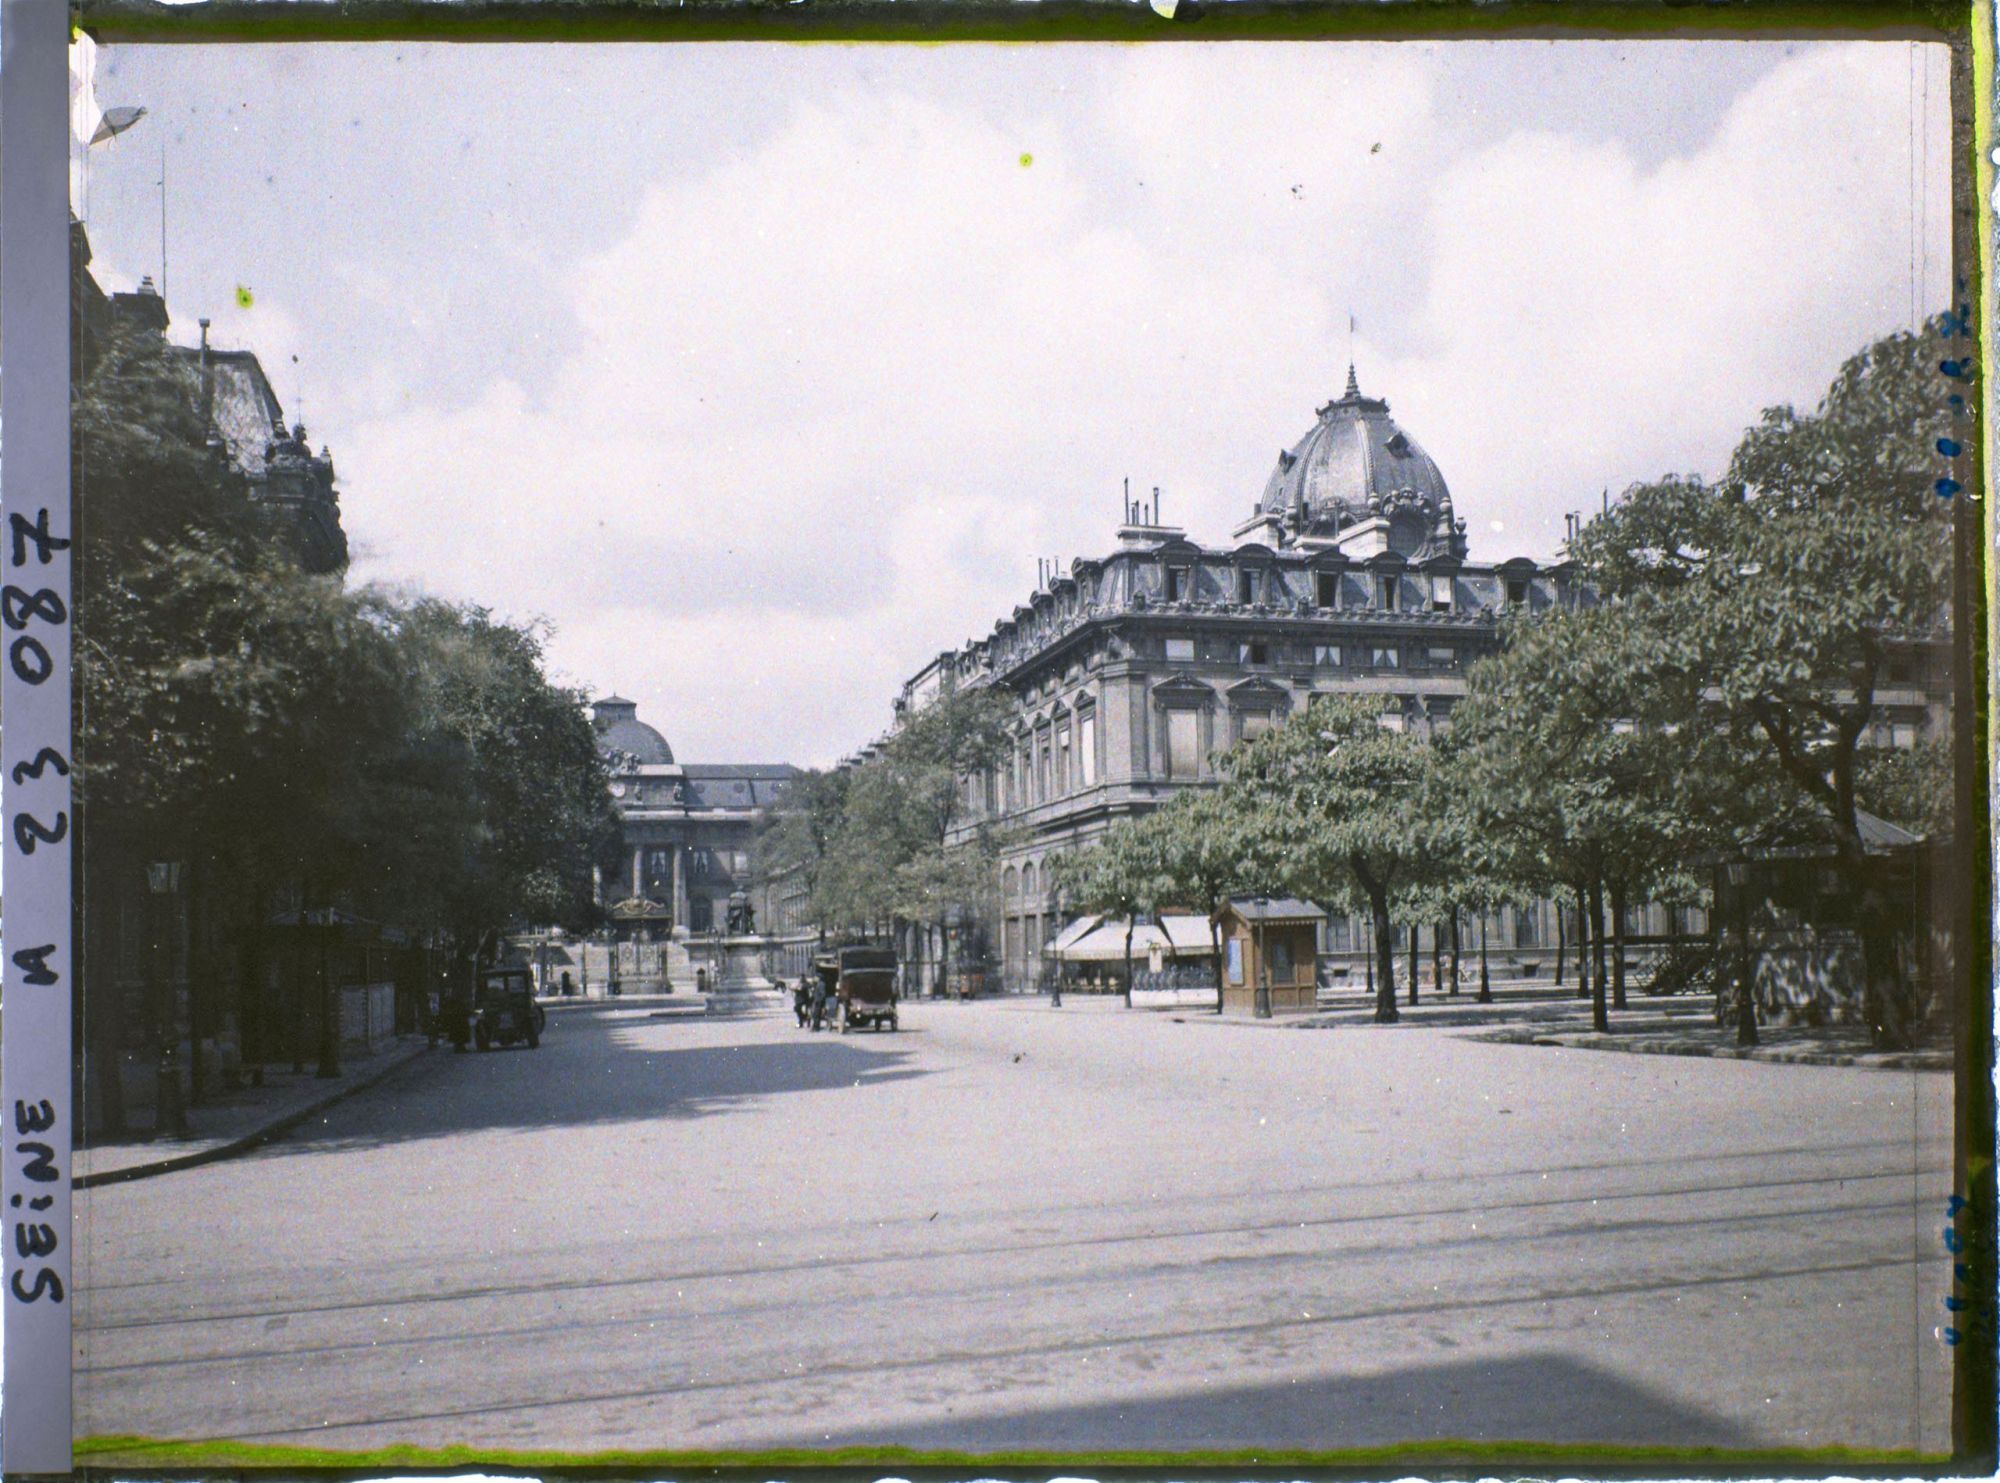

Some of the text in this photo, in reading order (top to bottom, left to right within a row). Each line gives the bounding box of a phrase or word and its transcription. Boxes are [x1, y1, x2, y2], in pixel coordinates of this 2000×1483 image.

[3, 507, 70, 686] 087
[12, 747, 70, 856] 23
[12, 943, 59, 986] A
